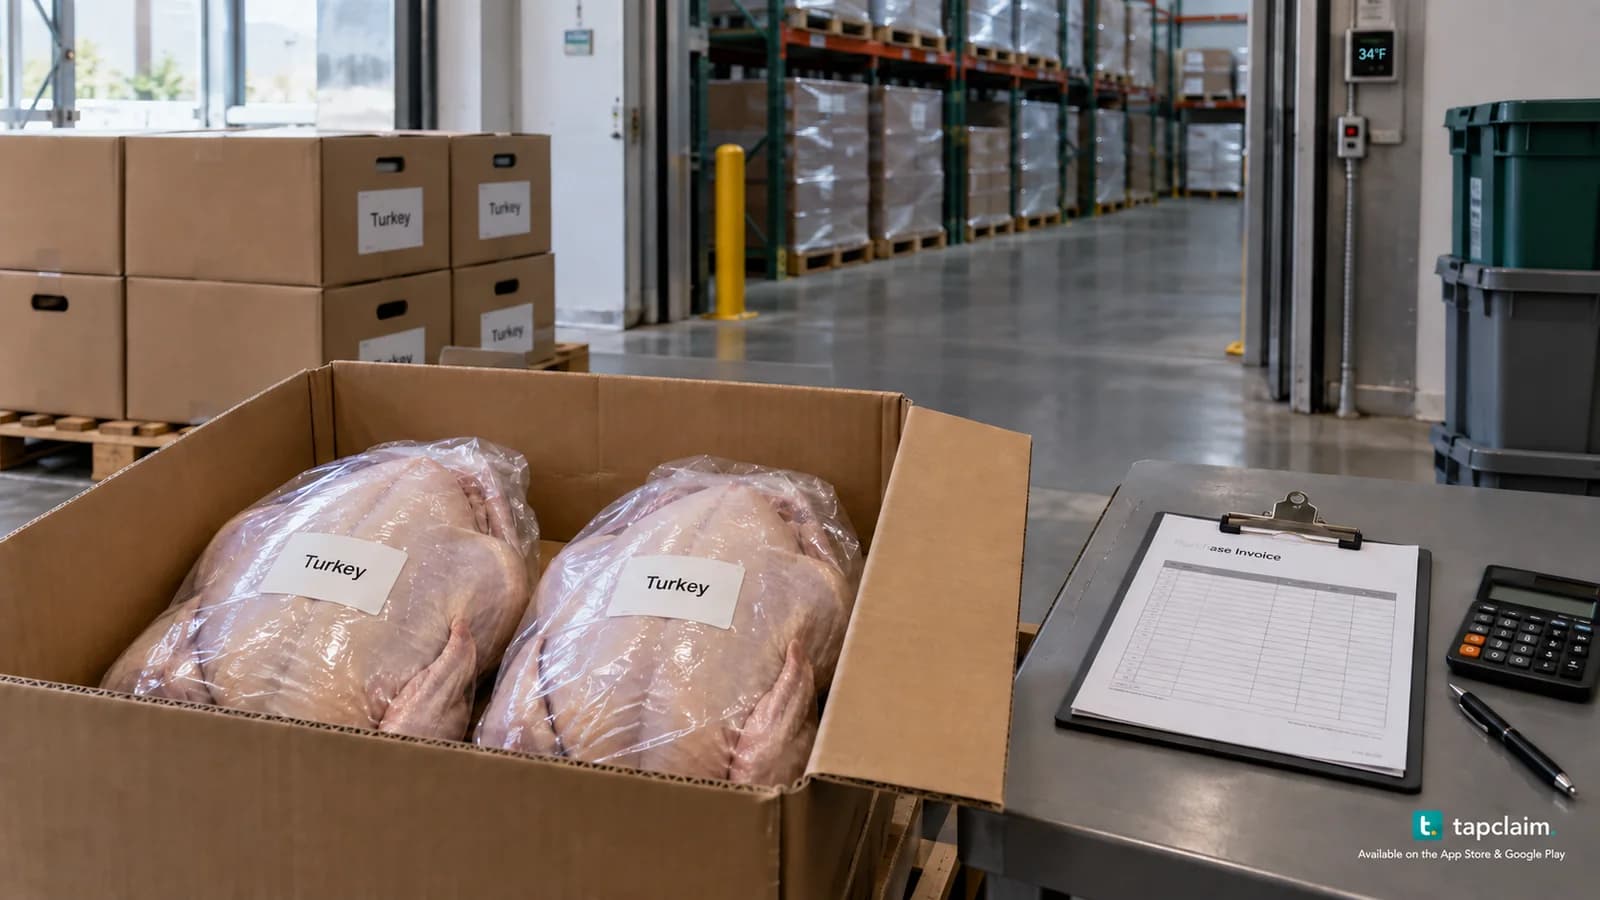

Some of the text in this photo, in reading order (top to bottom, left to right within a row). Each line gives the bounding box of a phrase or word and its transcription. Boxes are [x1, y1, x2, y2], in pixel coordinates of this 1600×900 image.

[1359, 47, 1387, 60] 34°F
[488, 201, 522, 217] Turkey
[370, 211, 412, 228] Turkey
[491, 325, 524, 342] Turkey
[1235, 547, 1282, 561] Invoice
[304, 554, 367, 581] Turkey
[646, 575, 710, 597] Turkey
